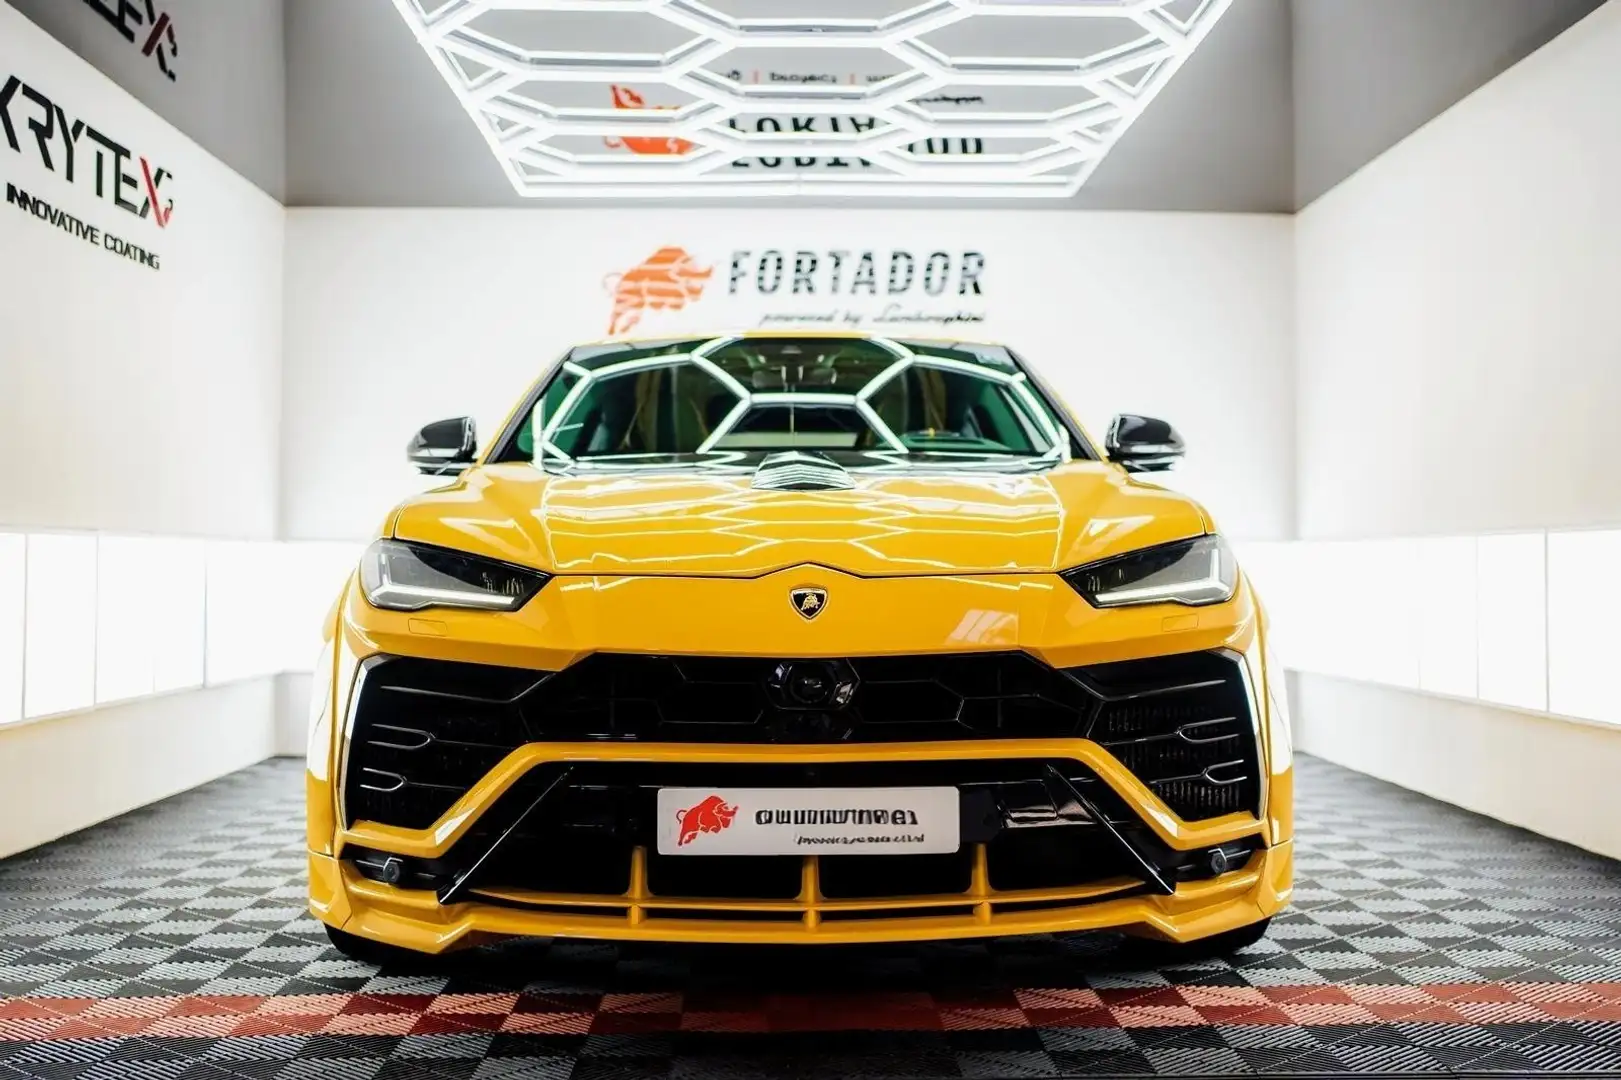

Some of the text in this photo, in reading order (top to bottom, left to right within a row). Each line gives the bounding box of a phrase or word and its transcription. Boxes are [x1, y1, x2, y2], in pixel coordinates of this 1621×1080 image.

[6, 182, 160, 270] INNOVATIVE COATING
[729, 250, 985, 295] FORTADOR
[843, 310, 863, 328] by
